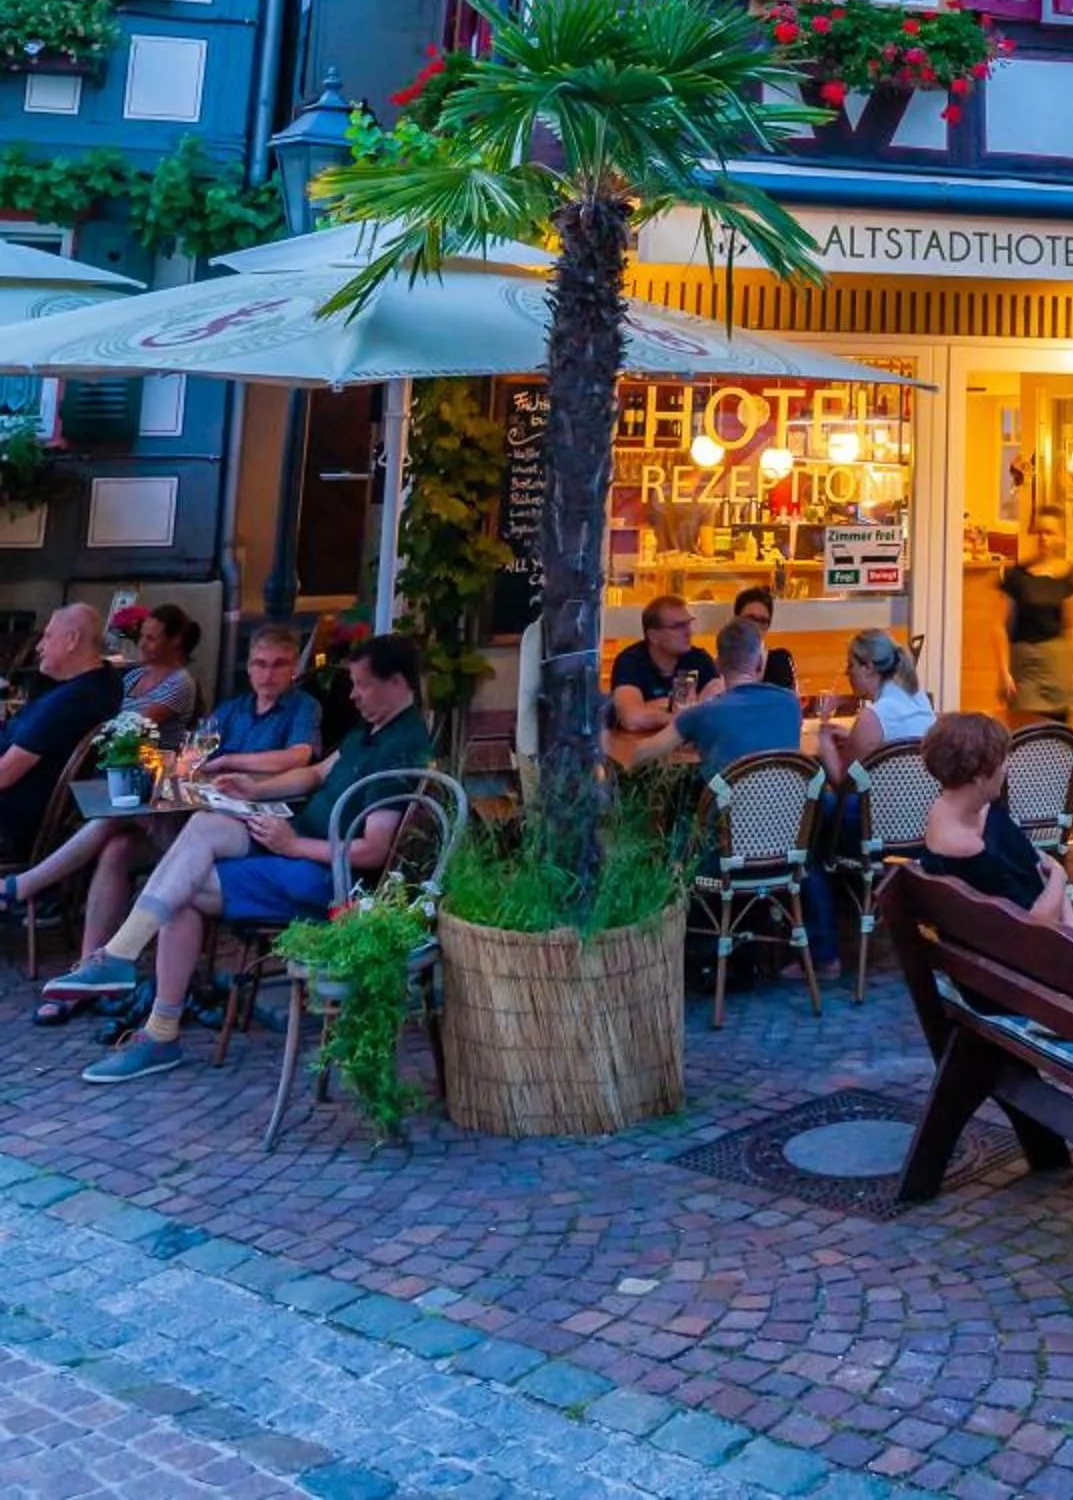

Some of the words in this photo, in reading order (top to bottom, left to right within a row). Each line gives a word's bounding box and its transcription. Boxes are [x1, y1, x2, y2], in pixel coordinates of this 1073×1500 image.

[644, 386, 882, 451] HOTEL
[828, 530, 872, 542] Zimmer
[876, 530, 895, 541] frei
